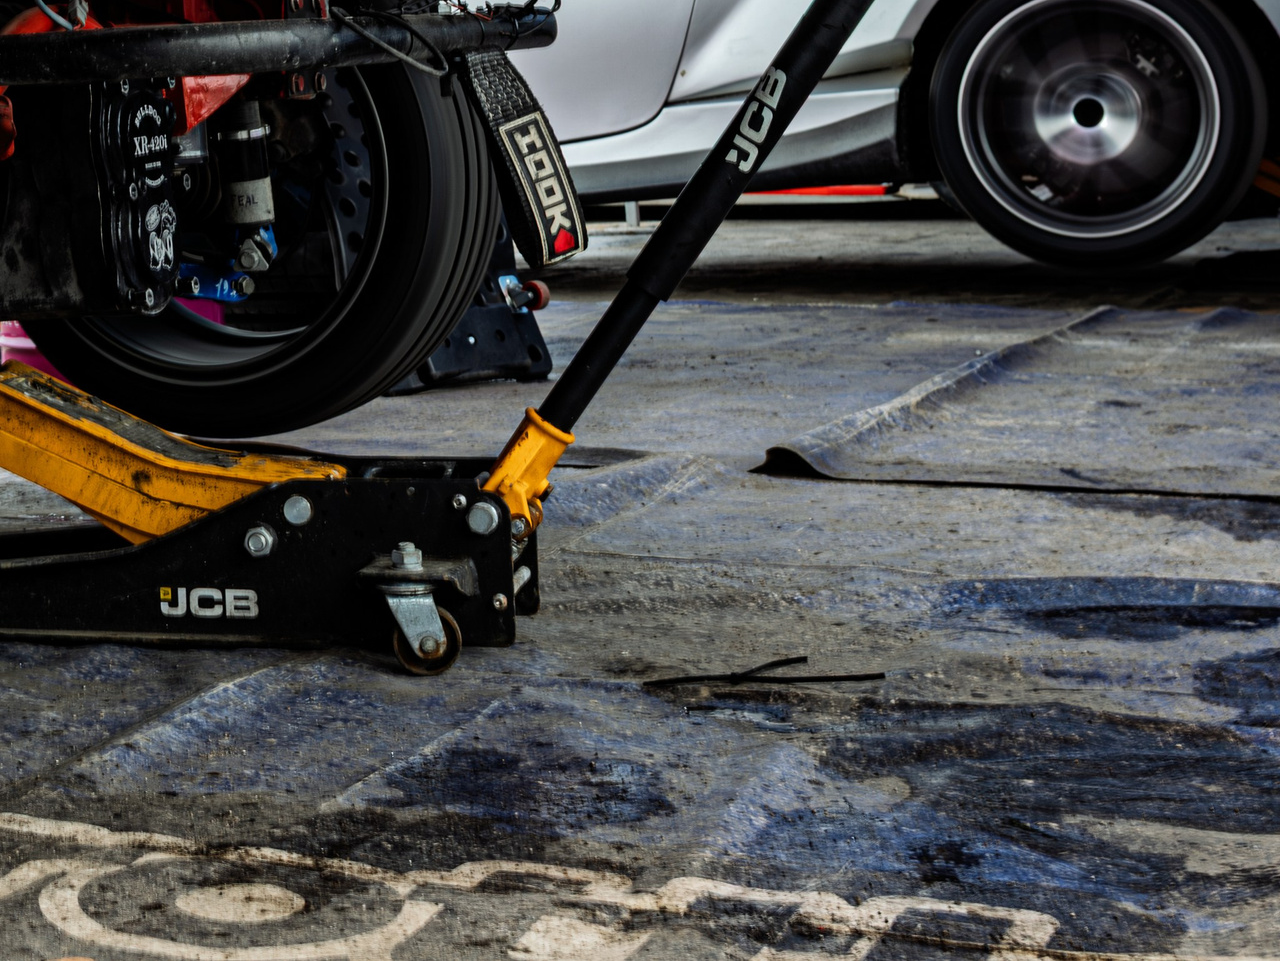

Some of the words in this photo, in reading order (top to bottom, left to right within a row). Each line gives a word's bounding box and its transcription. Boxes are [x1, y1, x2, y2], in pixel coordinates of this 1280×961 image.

[133, 134, 168, 157] XR-420i
[725, 66, 788, 175] JCB
[513, 123, 572, 236] HOOK
[160, 586, 260, 618] JCB
